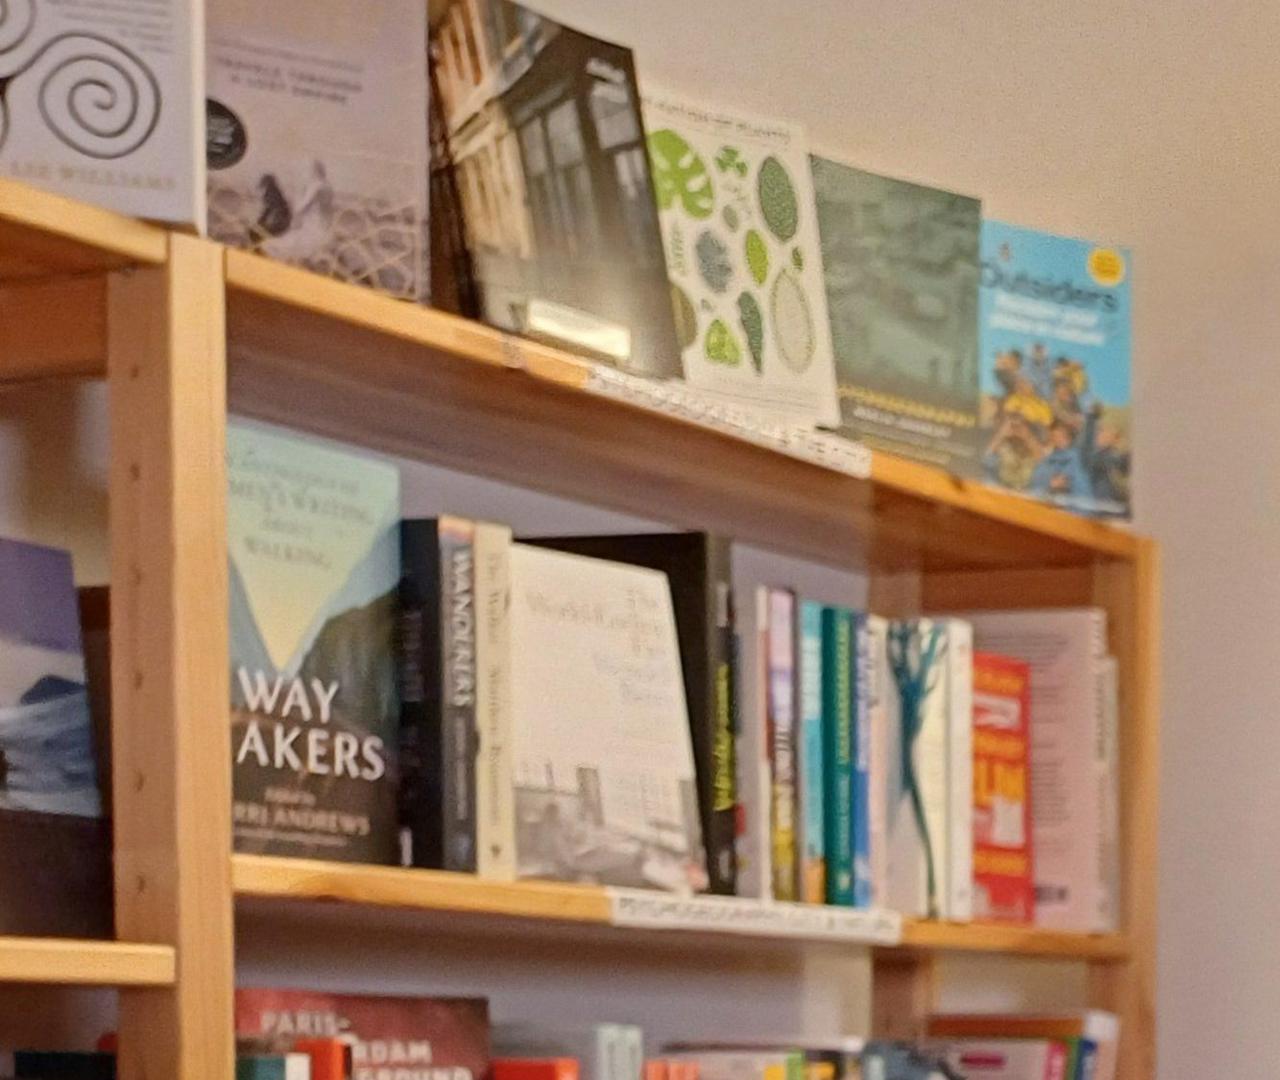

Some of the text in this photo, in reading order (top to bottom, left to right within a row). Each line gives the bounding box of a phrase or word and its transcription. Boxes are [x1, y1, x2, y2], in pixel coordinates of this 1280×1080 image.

[237, 665, 339, 724] WAY
[235, 719, 386, 782] AKERS
[272, 805, 371, 837] ANDREWS
[353, 1038, 432, 1065] RDAM
